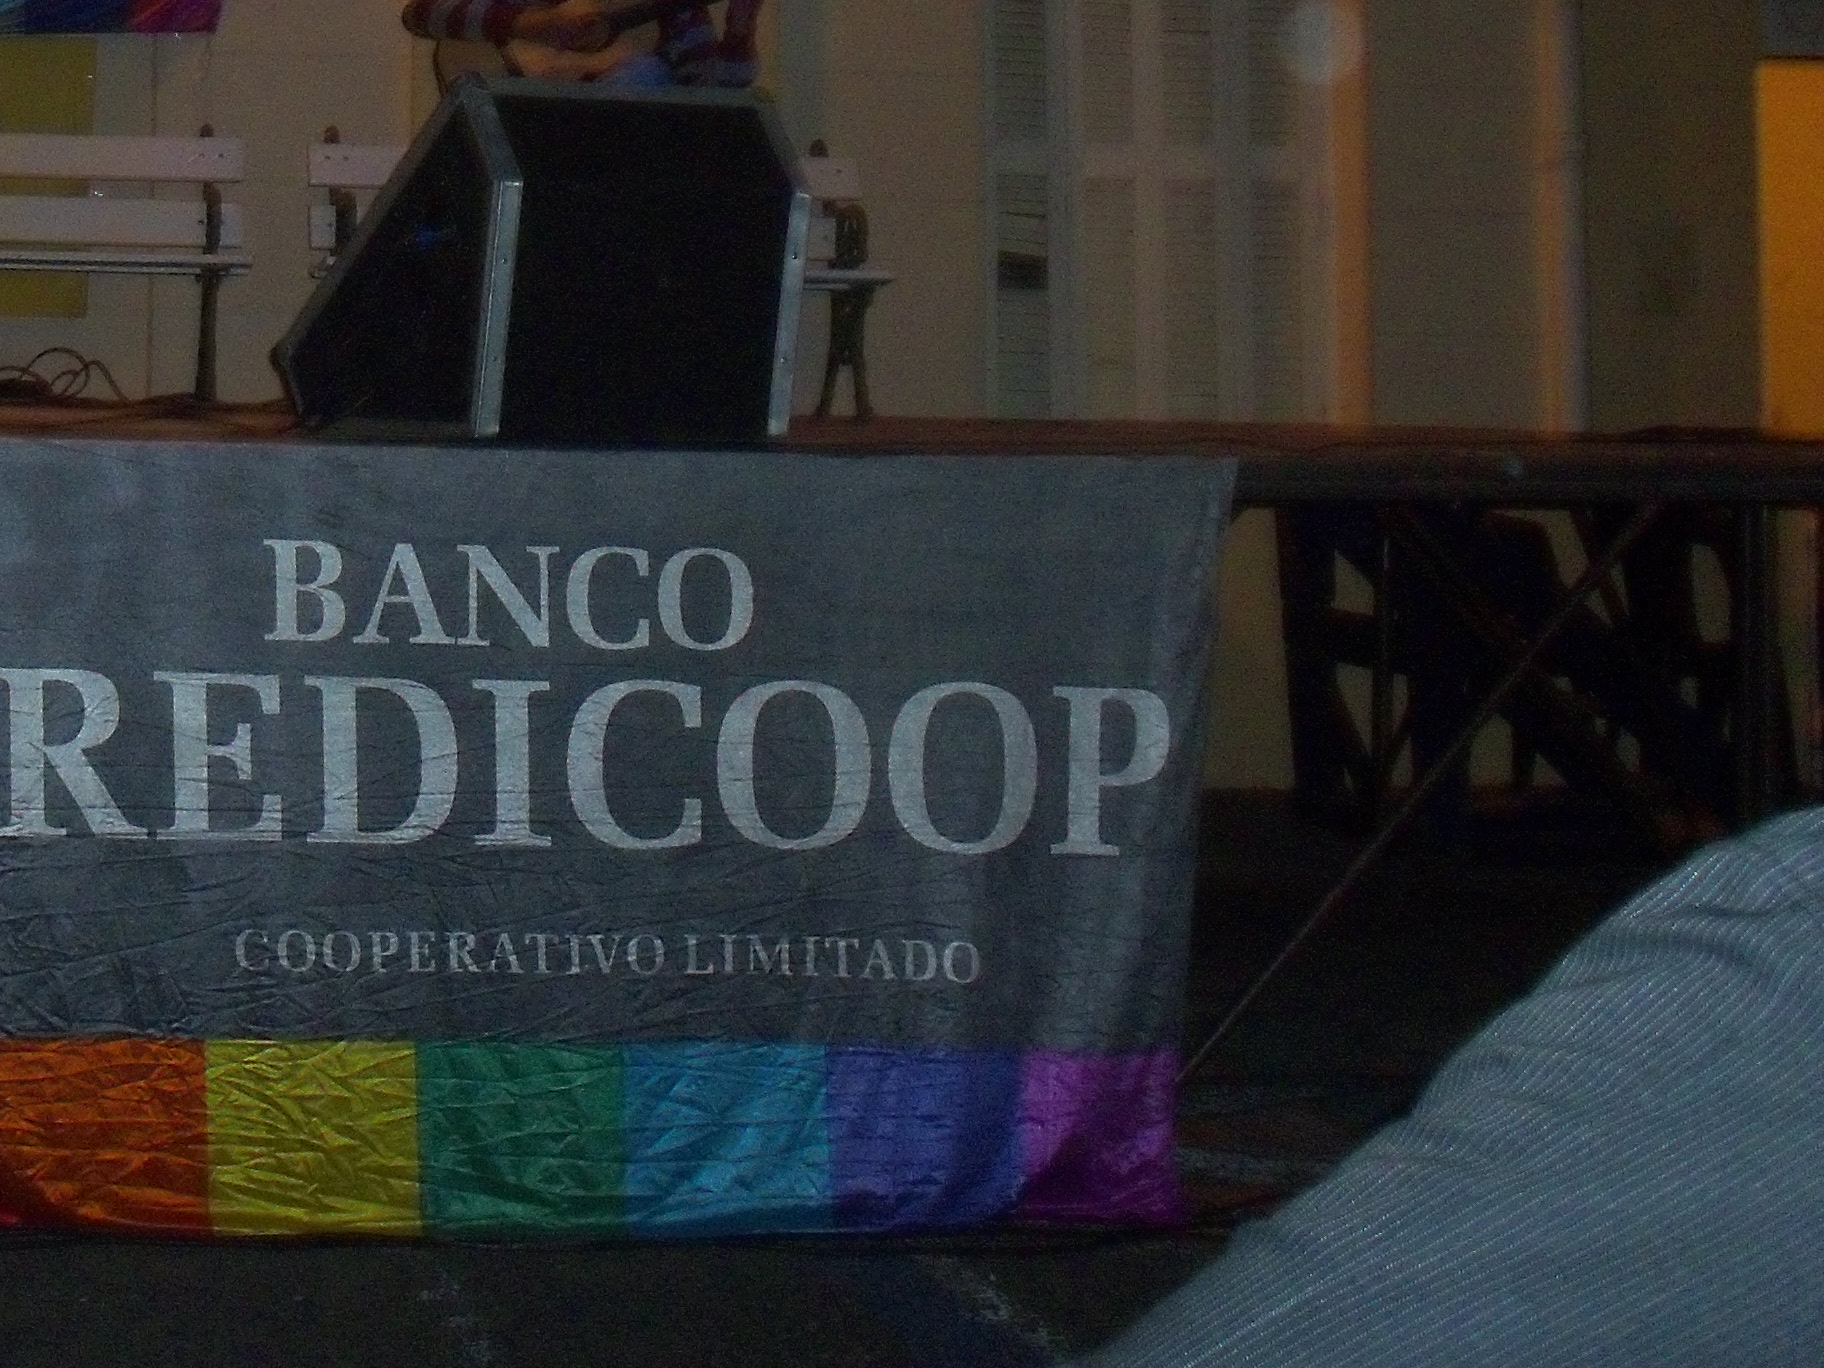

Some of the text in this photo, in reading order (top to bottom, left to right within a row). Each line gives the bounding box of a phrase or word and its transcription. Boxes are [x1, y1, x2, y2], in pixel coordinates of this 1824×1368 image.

[263, 538, 755, 651] BANCO
[234, 929, 980, 984] COOPERATIVO LIMITADO
